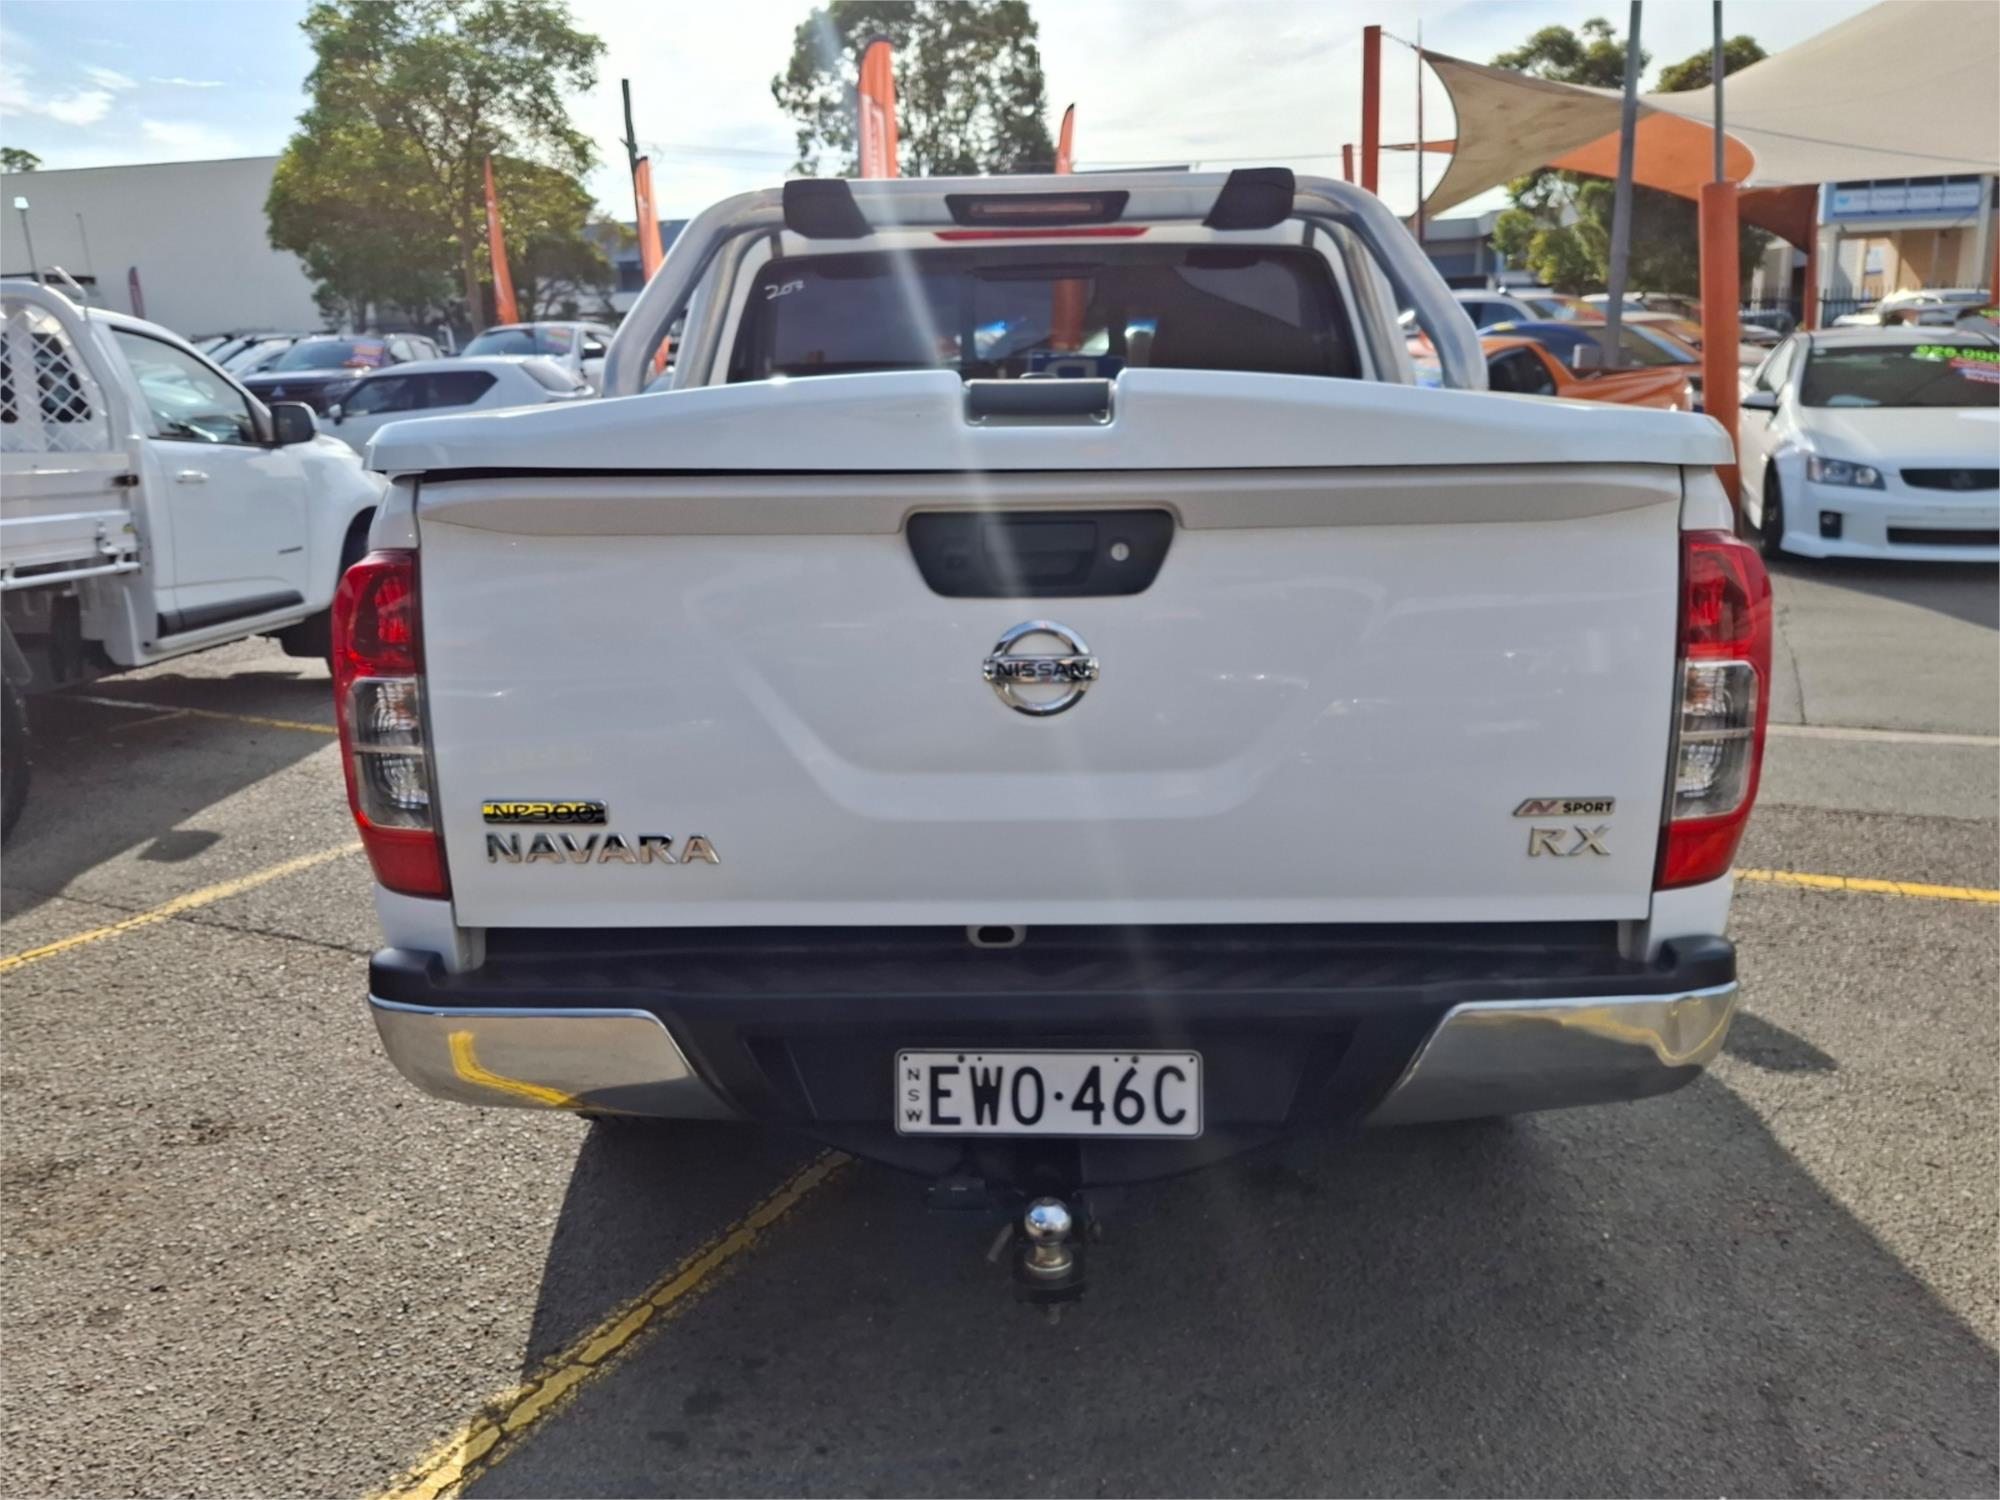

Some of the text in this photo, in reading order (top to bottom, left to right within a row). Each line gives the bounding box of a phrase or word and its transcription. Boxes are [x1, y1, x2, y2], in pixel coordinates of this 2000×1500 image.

[996, 662, 1088, 678] NISSAN
[492, 802, 598, 824] NP300
[1562, 801, 1613, 814] SPORT
[485, 832, 721, 866] NAVARA
[1528, 824, 1612, 857] RX
